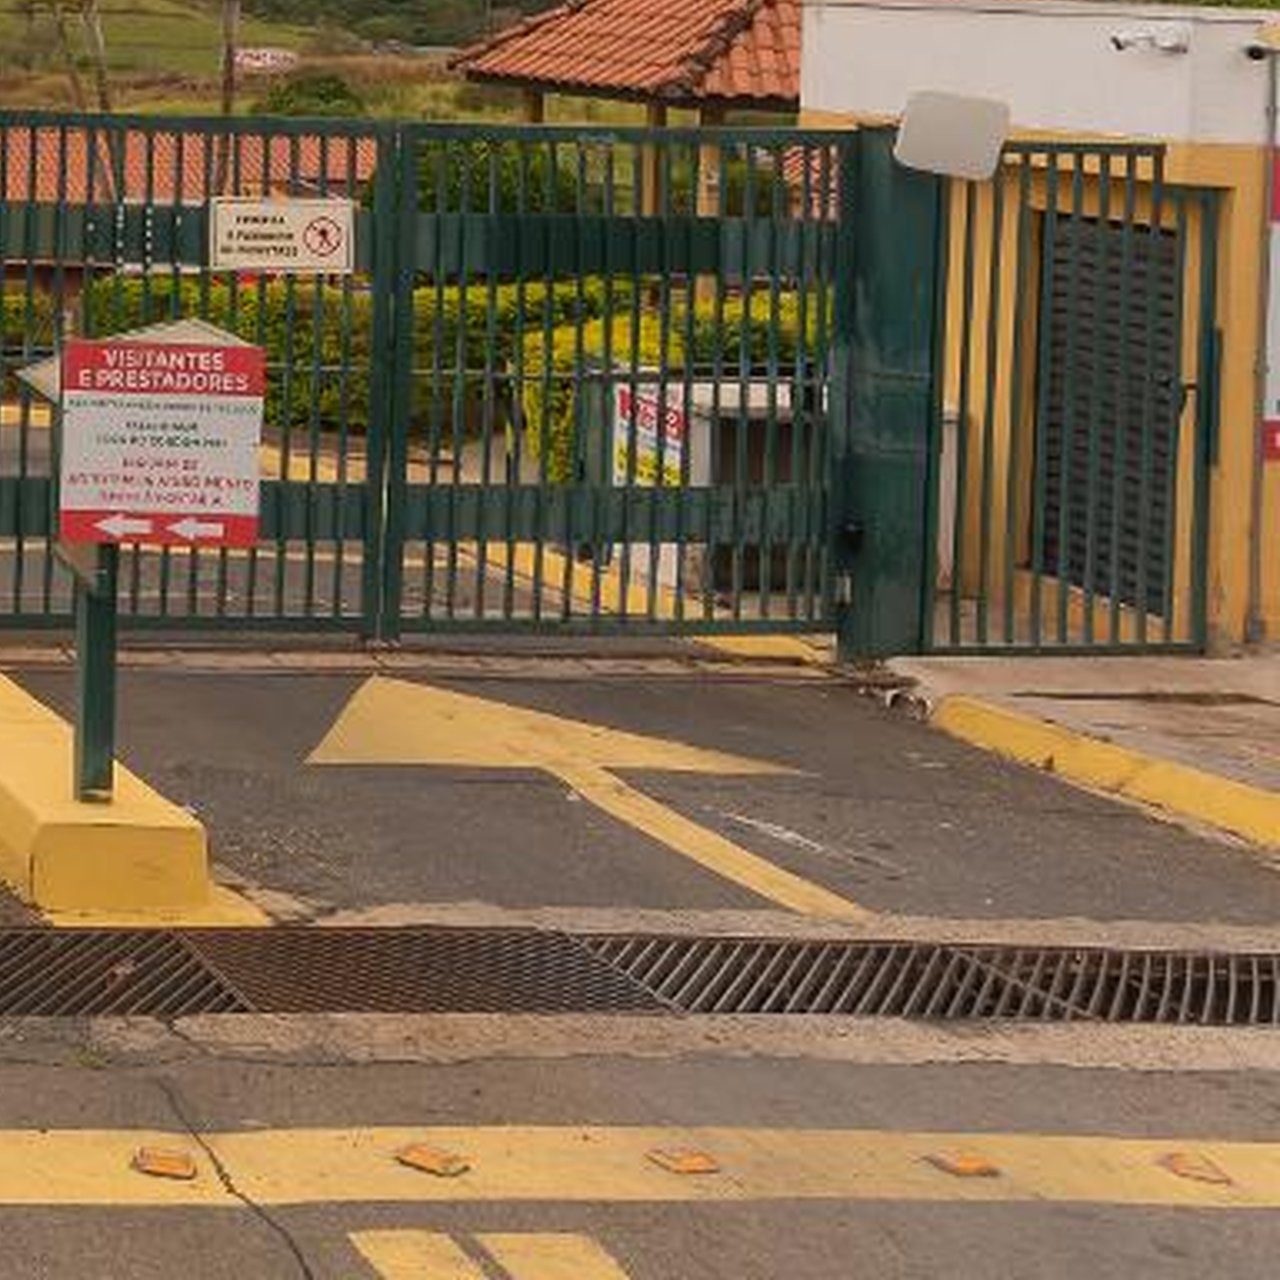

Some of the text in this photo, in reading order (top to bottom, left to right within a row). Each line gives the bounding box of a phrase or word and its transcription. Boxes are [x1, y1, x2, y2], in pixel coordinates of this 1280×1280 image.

[104, 349, 225, 370] VISITANTES
[78, 369, 249, 391] E PRESTADORES
